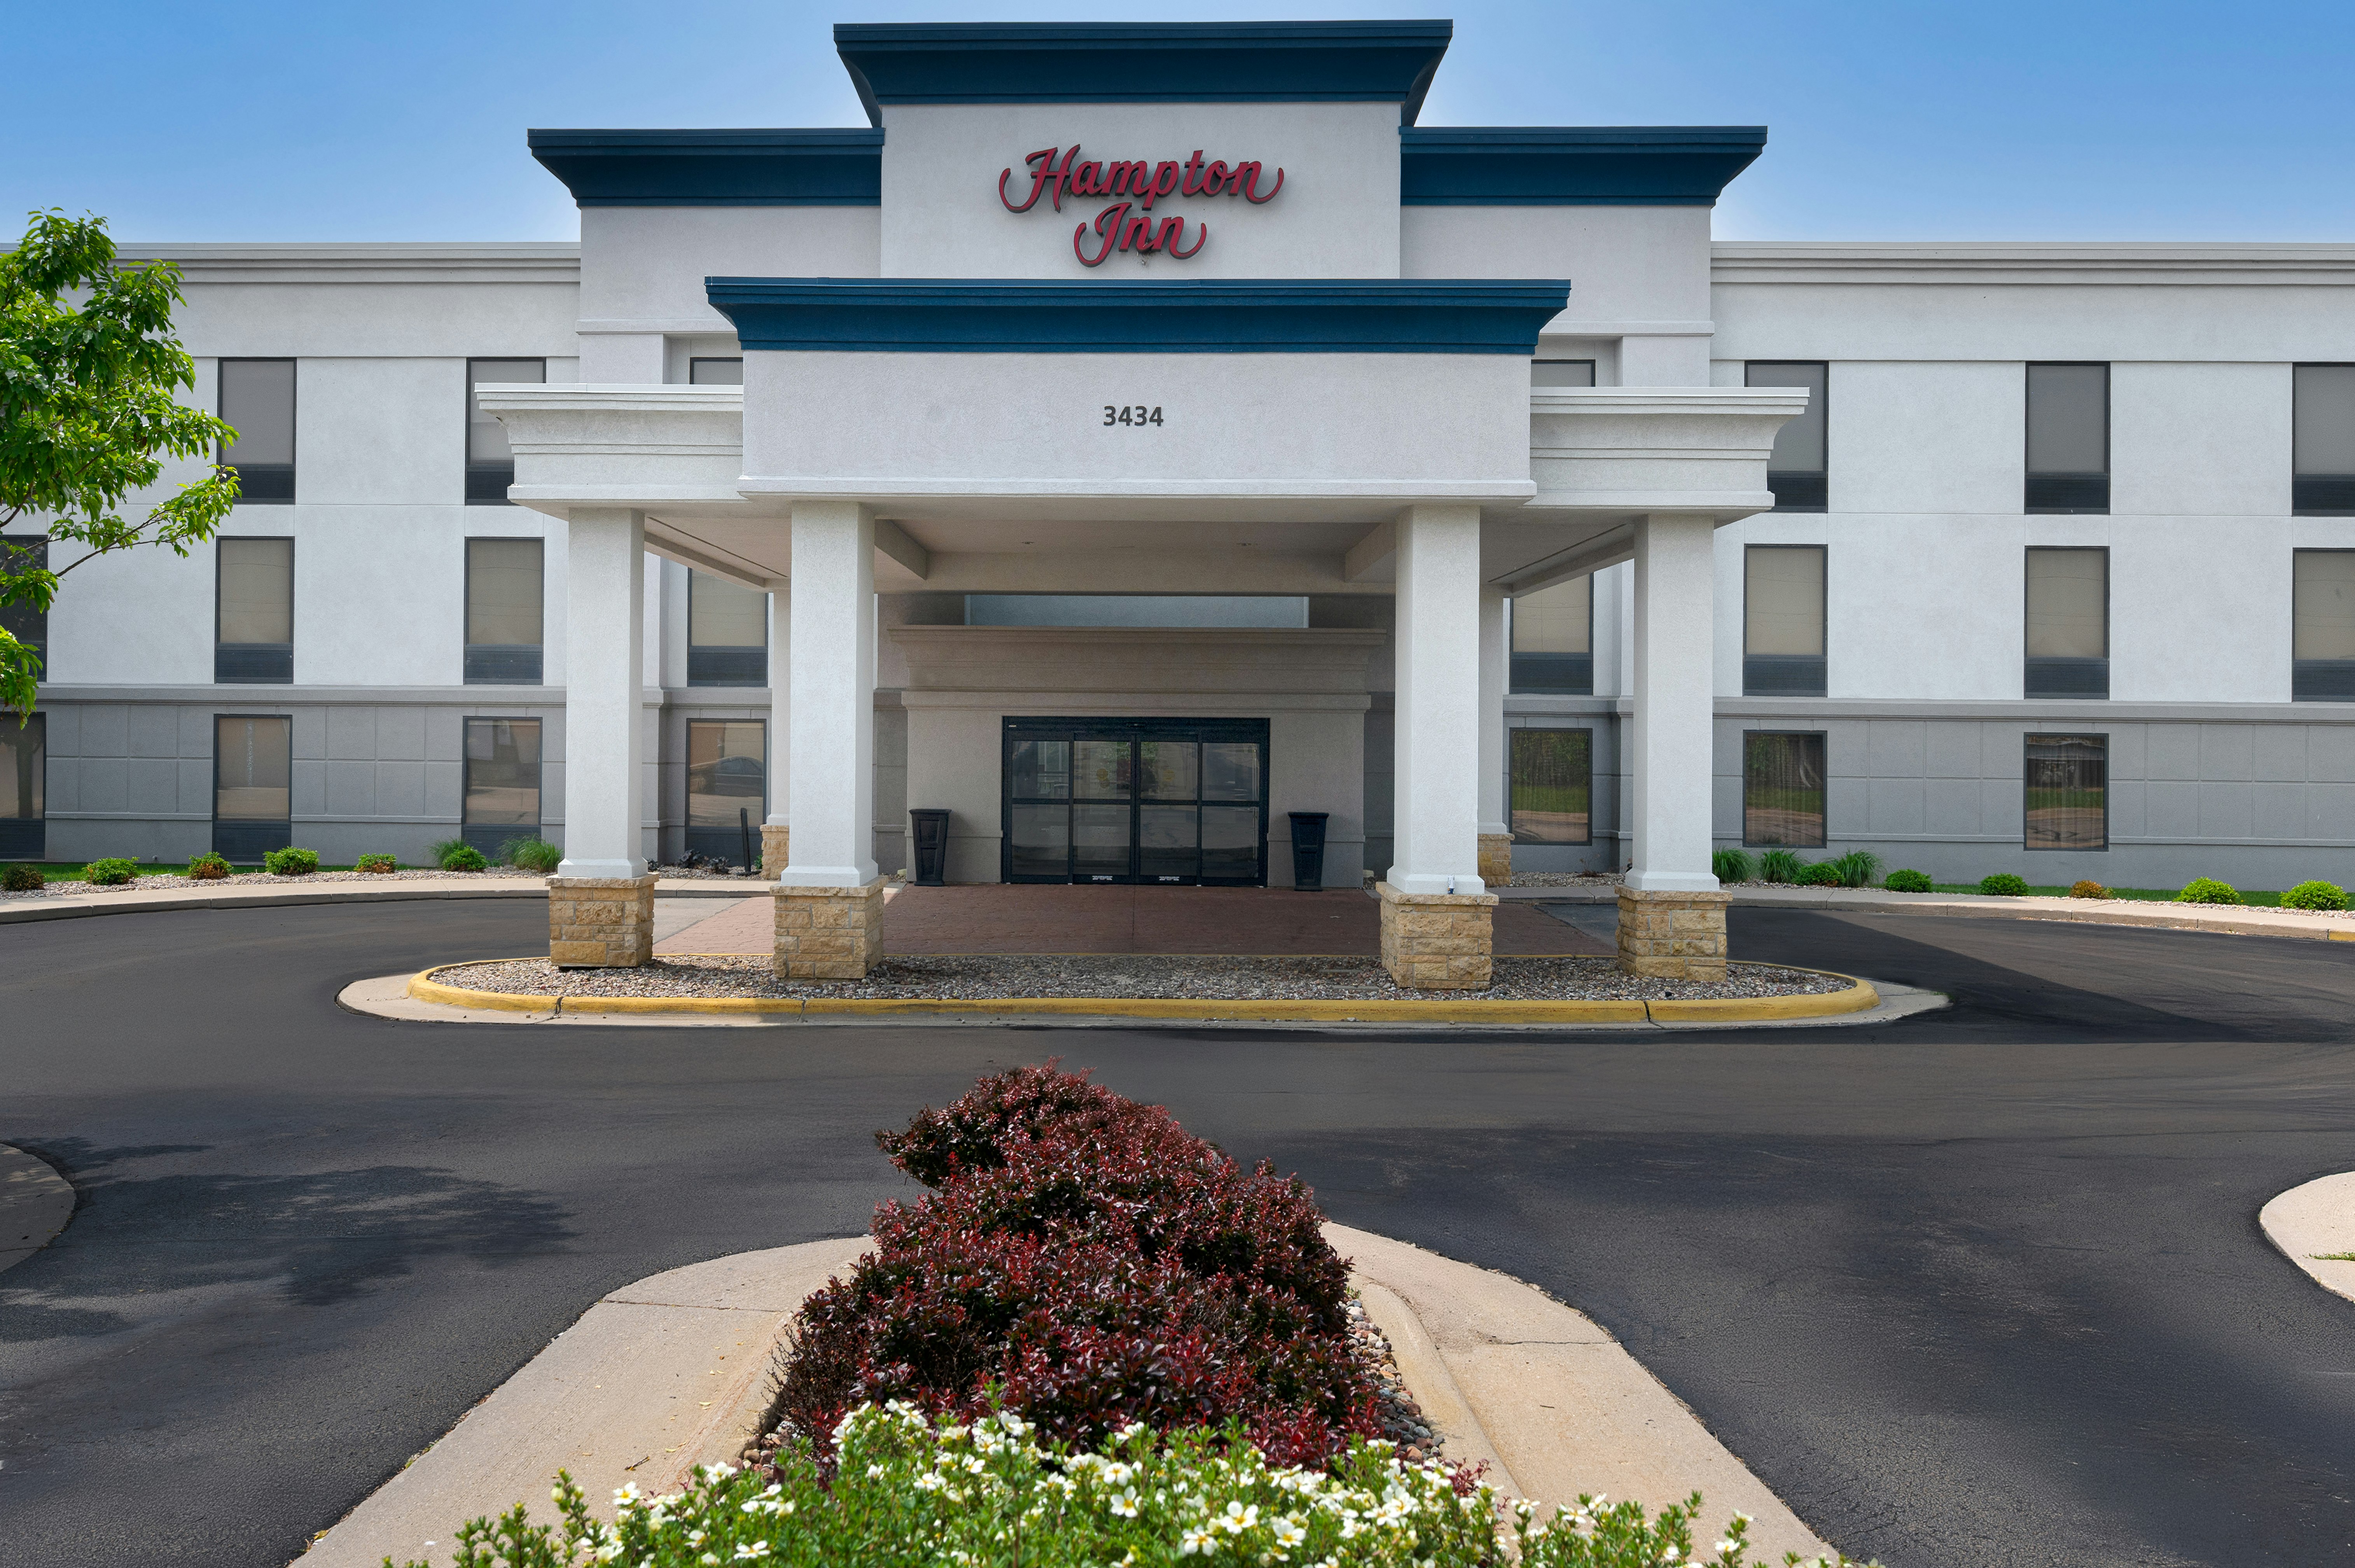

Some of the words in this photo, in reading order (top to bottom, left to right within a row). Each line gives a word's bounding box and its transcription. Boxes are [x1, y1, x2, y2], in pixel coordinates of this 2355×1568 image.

[999, 144, 1284, 213] Hampton
[1073, 202, 1207, 267] Inn
[1103, 406, 1163, 427] 3434
